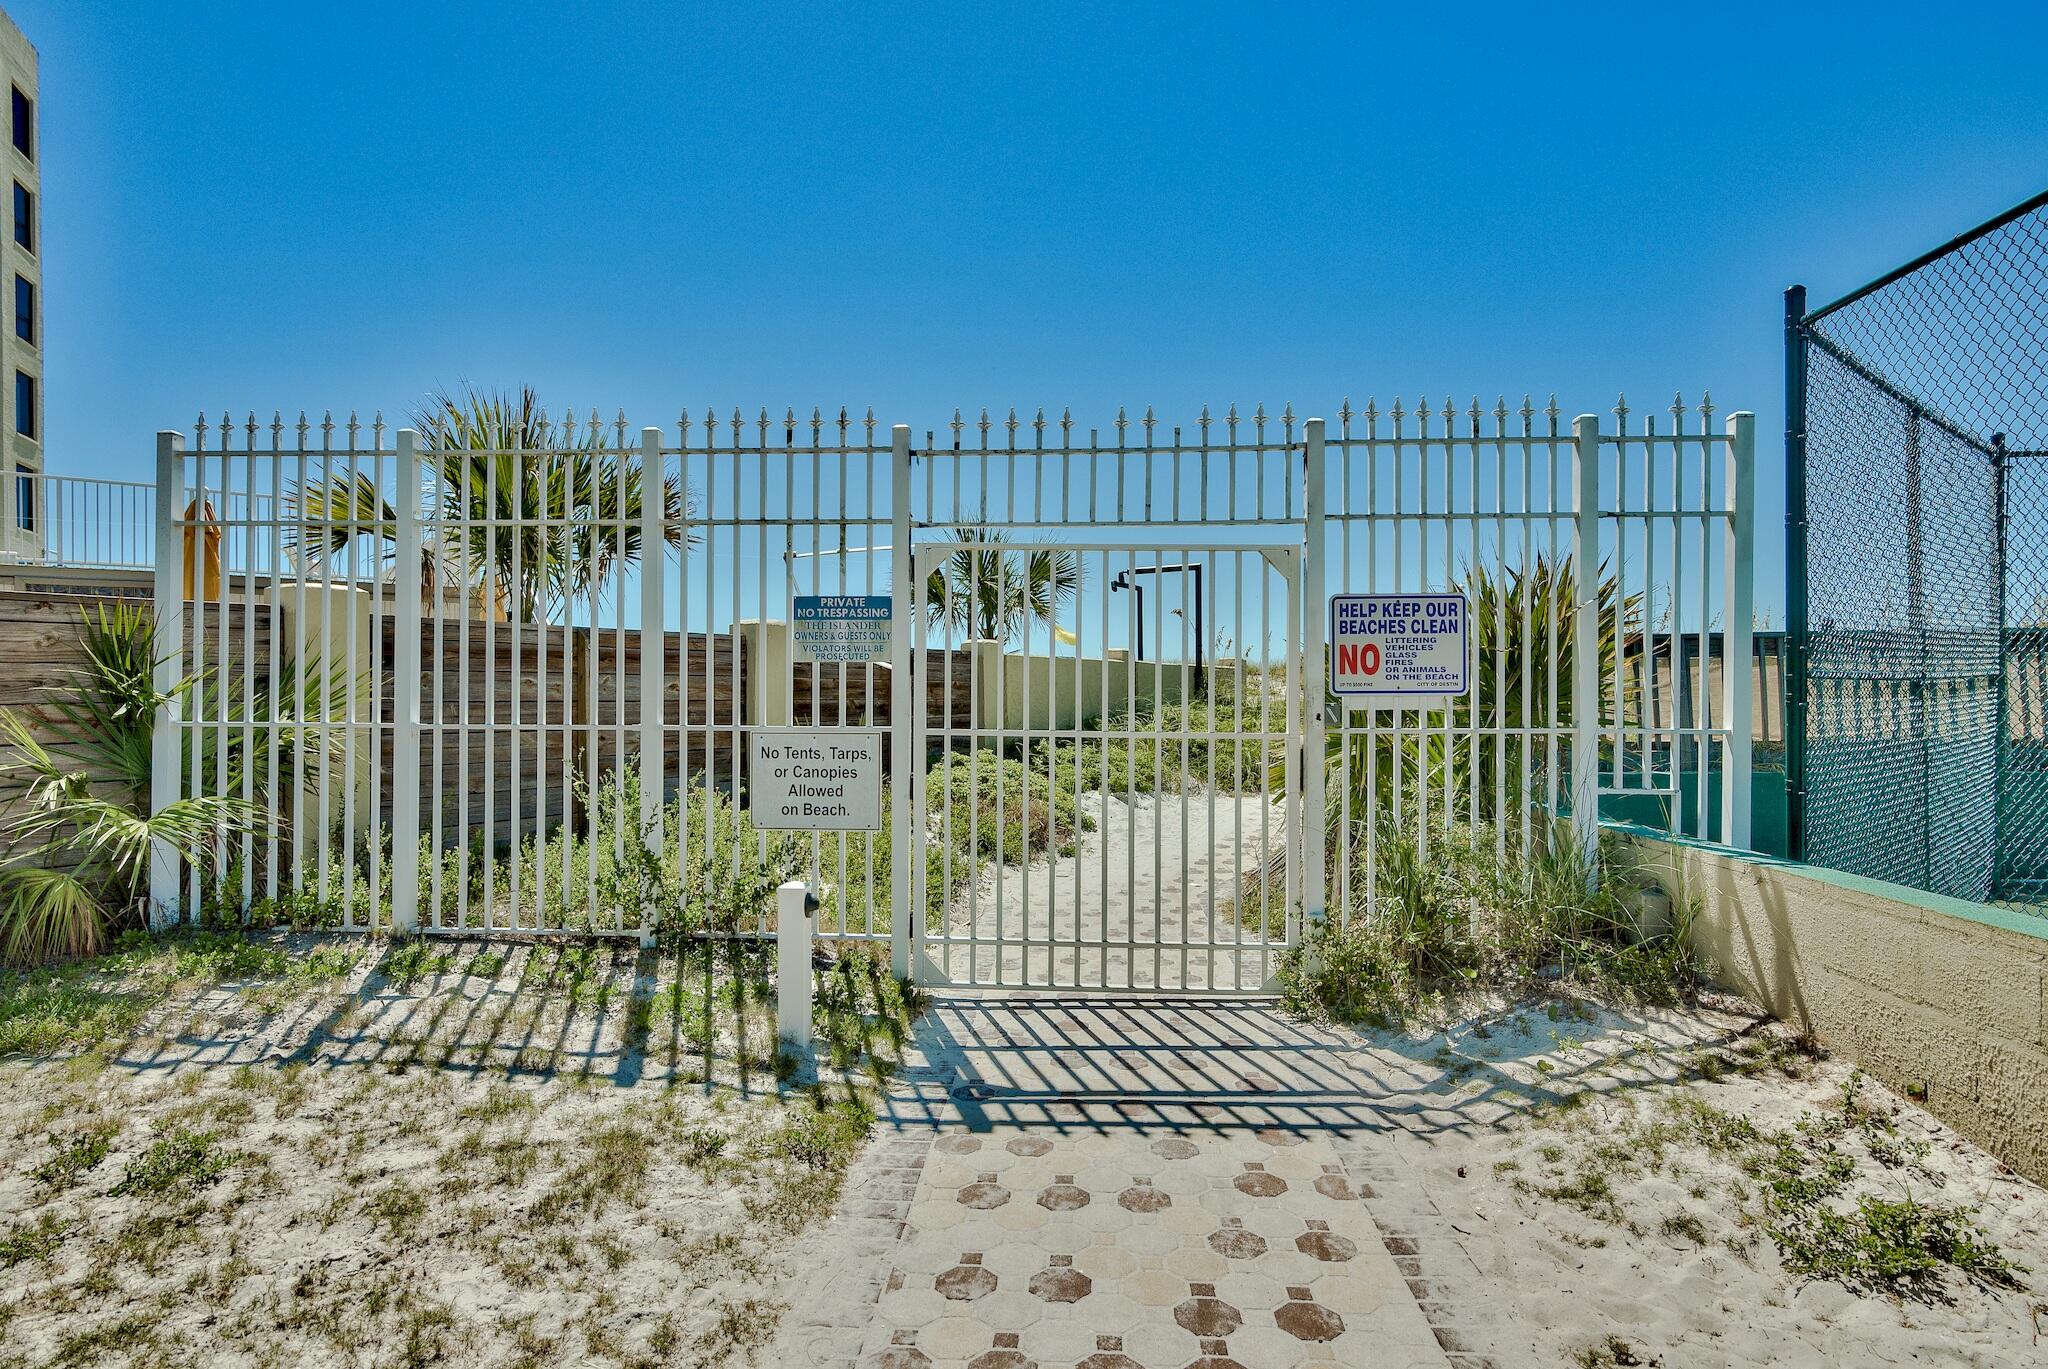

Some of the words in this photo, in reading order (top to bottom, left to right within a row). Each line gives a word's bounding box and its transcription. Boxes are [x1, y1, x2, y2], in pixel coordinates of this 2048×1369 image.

[820, 598, 865, 607] PRIVATE
[798, 608, 815, 617] NO
[817, 608, 889, 617] TRESPASSING
[1340, 604, 1377, 617] HELP
[1382, 603, 1421, 617] KEEP
[1426, 602, 1458, 617] OUR
[805, 622, 828, 630] THE
[829, 622, 881, 630] ISLANDER
[1340, 620, 1406, 634] BEACHES
[1411, 620, 1458, 634] CLEAN
[795, 632, 828, 640] OWNERS
[830, 632, 835, 640] &
[838, 632, 867, 640] GUESTS
[869, 632, 891, 640] ONLY
[1339, 644, 1380, 675] NO
[761, 747, 779, 759] No
[784, 747, 825, 761] Tents,
[830, 747, 871, 762] Tarps,
[774, 768, 788, 778] or
[793, 765, 857, 781] Canopies
[788, 784, 843, 797] Allowed
[781, 805, 798, 816] on
[803, 803, 850, 816] Beach.
